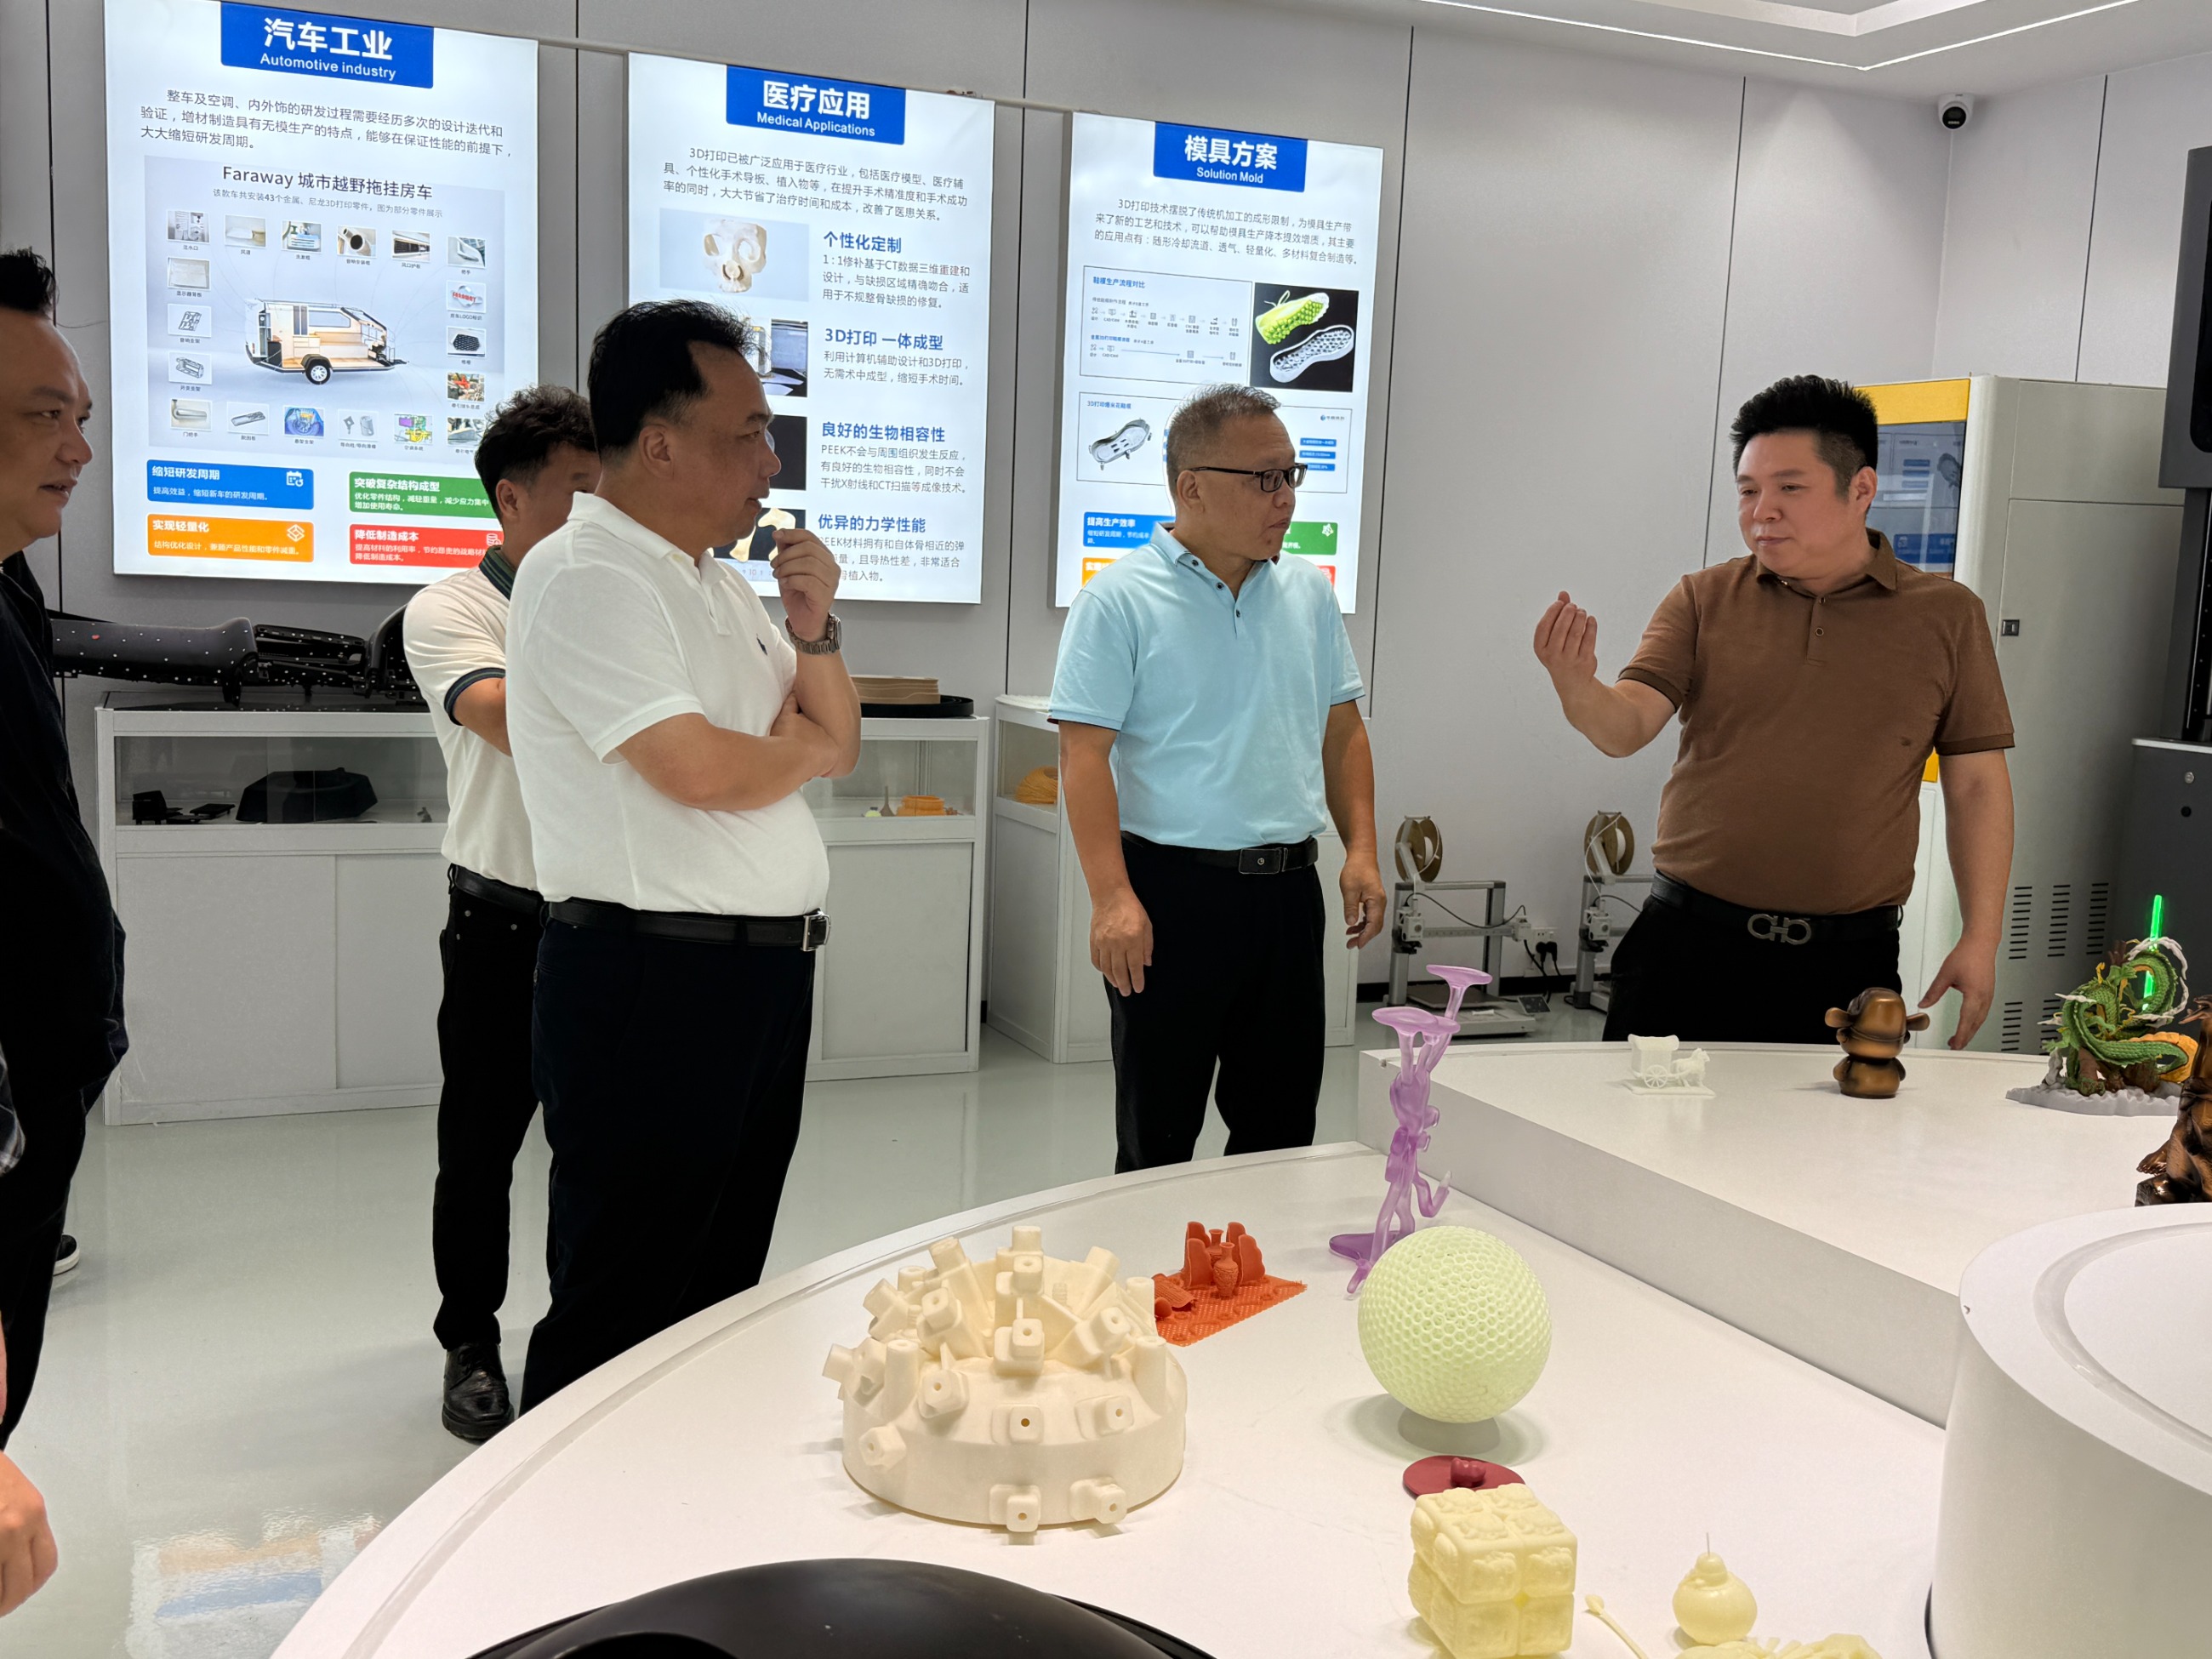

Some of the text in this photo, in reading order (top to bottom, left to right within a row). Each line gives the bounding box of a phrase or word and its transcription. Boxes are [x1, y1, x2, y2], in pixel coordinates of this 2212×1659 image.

[263, 17, 393, 61] 汽车工业
[259, 53, 396, 82] Automotive industry
[763, 80, 870, 120] 医疗应用
[167, 89, 504, 138] 整车及空调、内外饰的研发过程需要经历多次的设计迭代和
[756, 111, 876, 138] Medical Applications
[140, 105, 511, 157] 验证，增材制造具有无模生产的特点，能够在保证性能的前提下，
[140, 125, 255, 150] 大大缩短研发周期。
[1184, 134, 1278, 170] 模具方案
[689, 147, 964, 190] 3D打印已被广泛应用于医疗行业，包括医疗模型、医疗辅
[1196, 167, 1264, 184] Solution Mold
[222, 166, 433, 200] Faraway 城市越野拖挂房车
[663, 162, 967, 207] 具、个性化手术导板、植入物等，在提升手术精准度和手术成功
[663, 180, 940, 221] 率的同时，大大节省了治疗时间和成本，改善了医患关系。
[1118, 198, 1352, 233] 3D打印技术摆脱了传统机加工的成形限制，为模具生产带
[823, 231, 902, 254] 个性化定制
[1095, 213, 1355, 249] 来了新的工艺和技术，可以帮助模具生产降本提效增质，其主要
[823, 271, 969, 294] 设计，与缺损区域精确吻合，适
[823, 288, 942, 309] 用于不规整骨缺损的修复。
[824, 328, 944, 351] 3D打印 一体成型
[824, 350, 969, 370] 利用计算机辅助设计和3D打印，
[824, 368, 963, 386] 无需术中成型，缩短手术时间。
[822, 421, 946, 442] 良好的生物相容性
[821, 444, 966, 461] PEEK不会与周围组织发生反应，
[151, 465, 220, 480] 缩短研发周期
[820, 461, 965, 477] 有良好的生物相容性，同时不会
[354, 477, 441, 493] 突破复杂结构成型
[820, 477, 966, 493] 干扰X射线和CT扫描等成像技术。
[151, 519, 210, 533] 实现轻量化
[818, 513, 926, 533] 优异的力学性能
[1086, 516, 1136, 528] 提高生产效率
[354, 529, 419, 542] 降低制造成本
[835, 553, 961, 568] 量，且导热性差，非常适合
